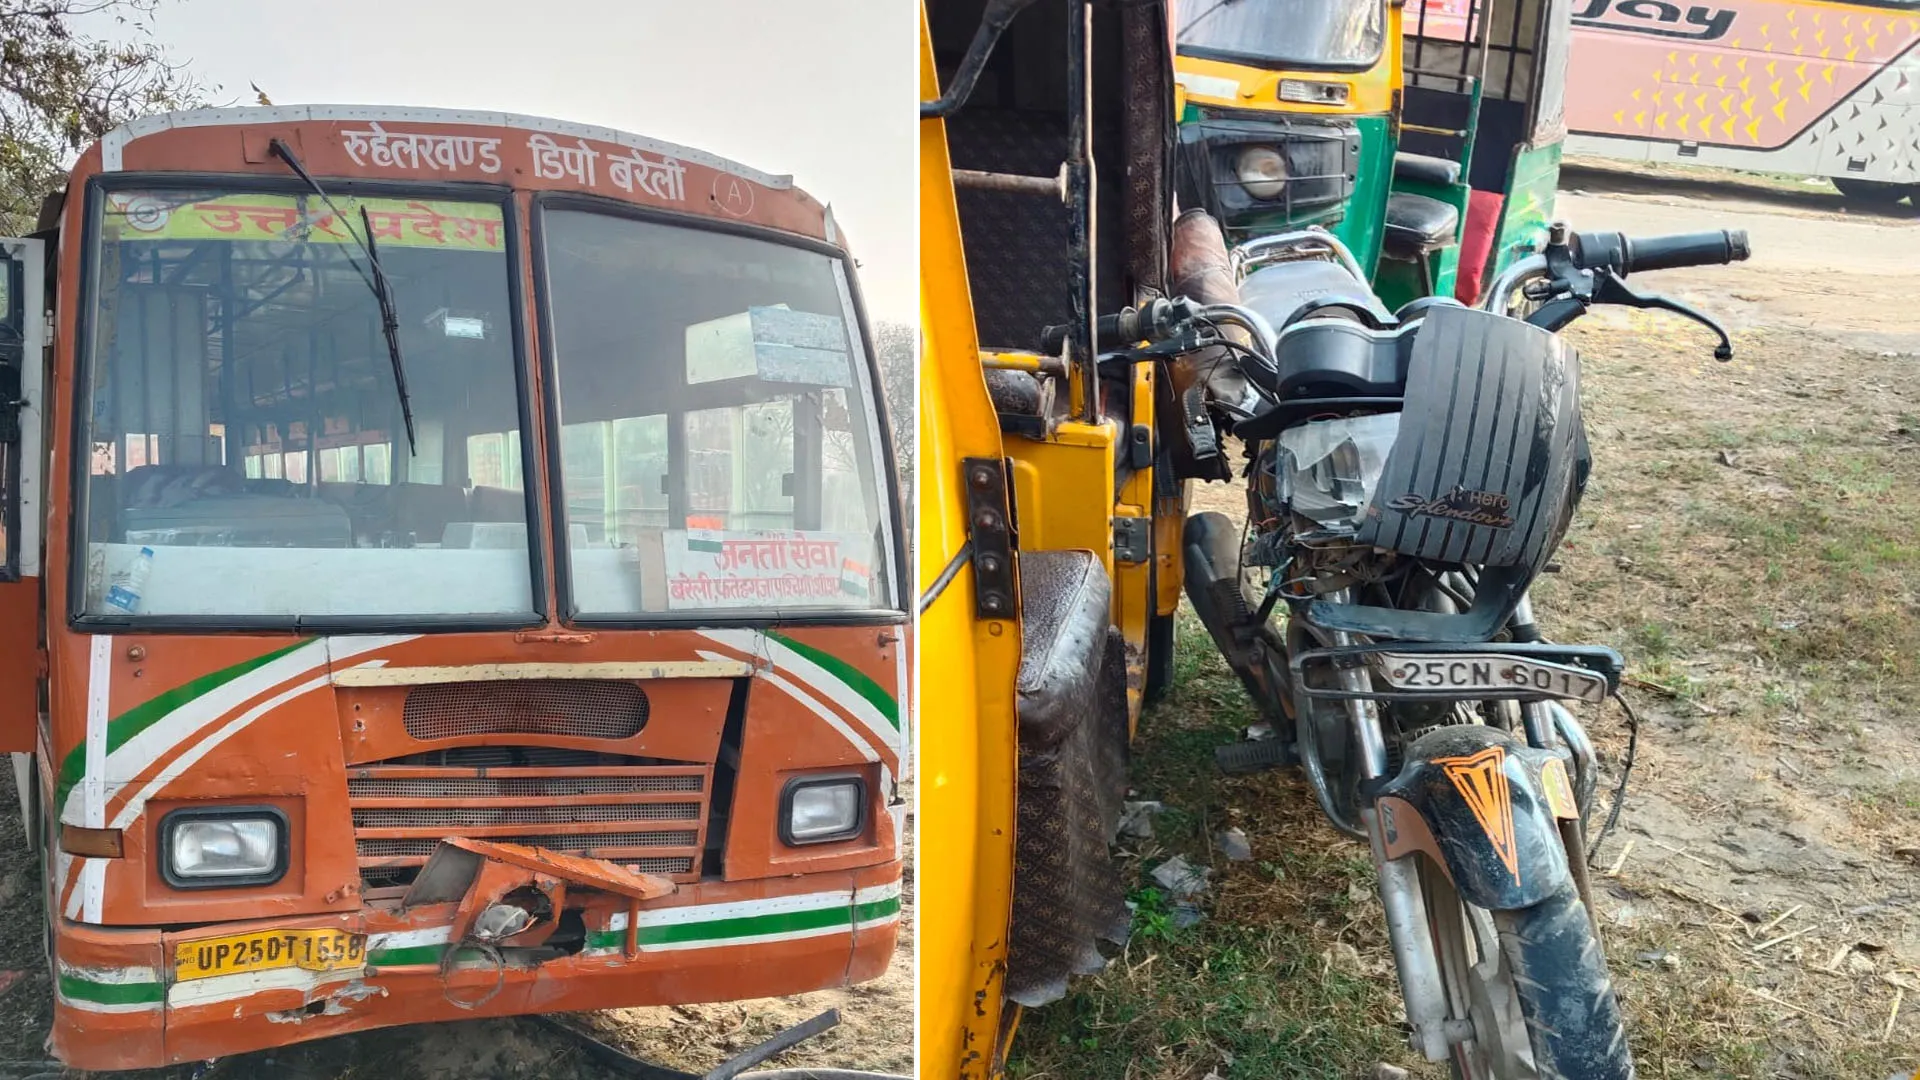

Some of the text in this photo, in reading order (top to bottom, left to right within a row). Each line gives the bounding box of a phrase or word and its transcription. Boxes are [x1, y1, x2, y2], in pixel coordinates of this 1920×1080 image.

[526, 133, 600, 187] डिपो
[607, 149, 687, 201] बरेली
[727, 180, 743, 205] A
[193, 203, 348, 239] उत्तर
[361, 202, 503, 248] प्रदेश
[1469, 491, 1511, 509] Hero
[714, 533, 839, 570] जनता सेवा
